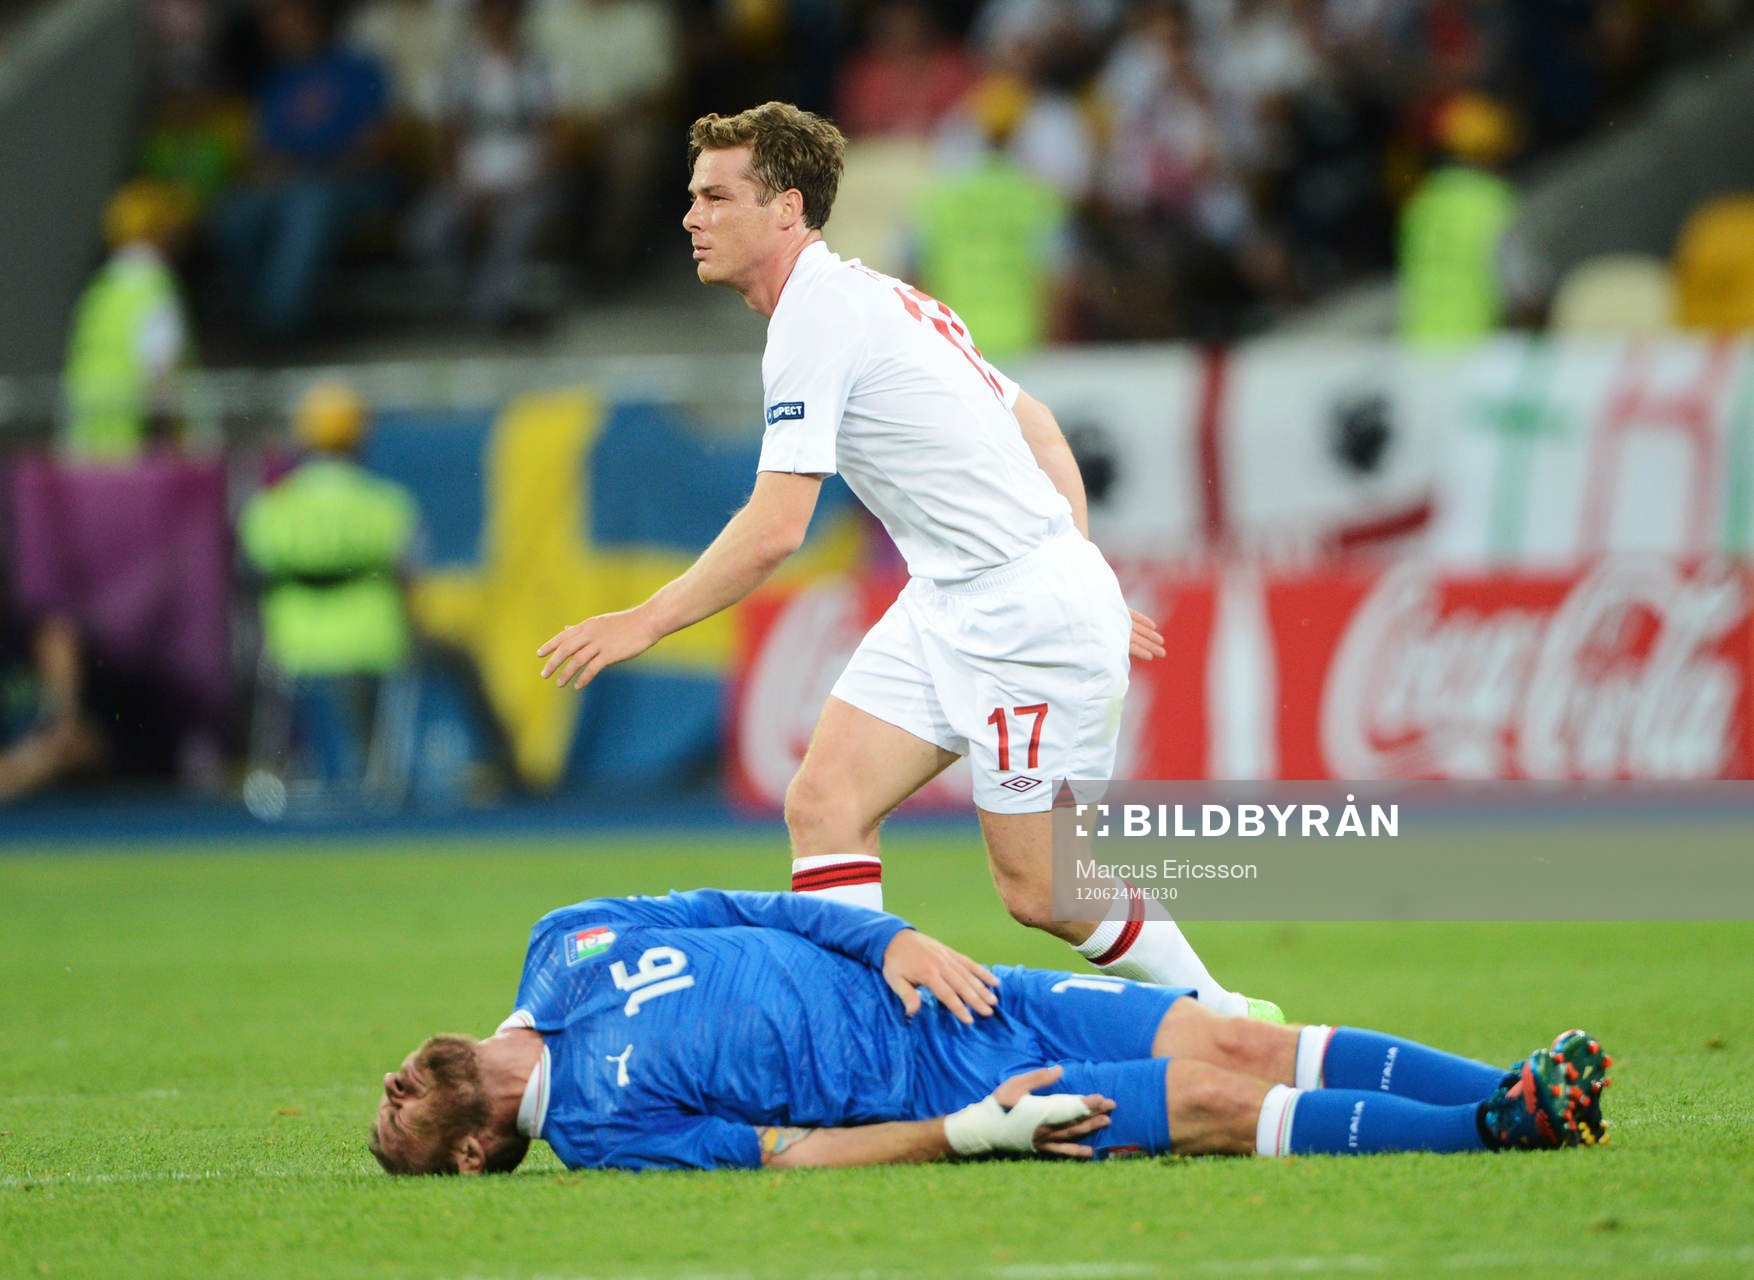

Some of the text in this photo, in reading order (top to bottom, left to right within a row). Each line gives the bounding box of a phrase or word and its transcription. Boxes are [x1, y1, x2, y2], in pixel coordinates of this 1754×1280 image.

[987, 702, 1049, 771] 17
[609, 946, 695, 1018] 16
[1380, 1046, 1399, 1091] ITALIA
[1348, 1101, 1365, 1148] ITALIA
